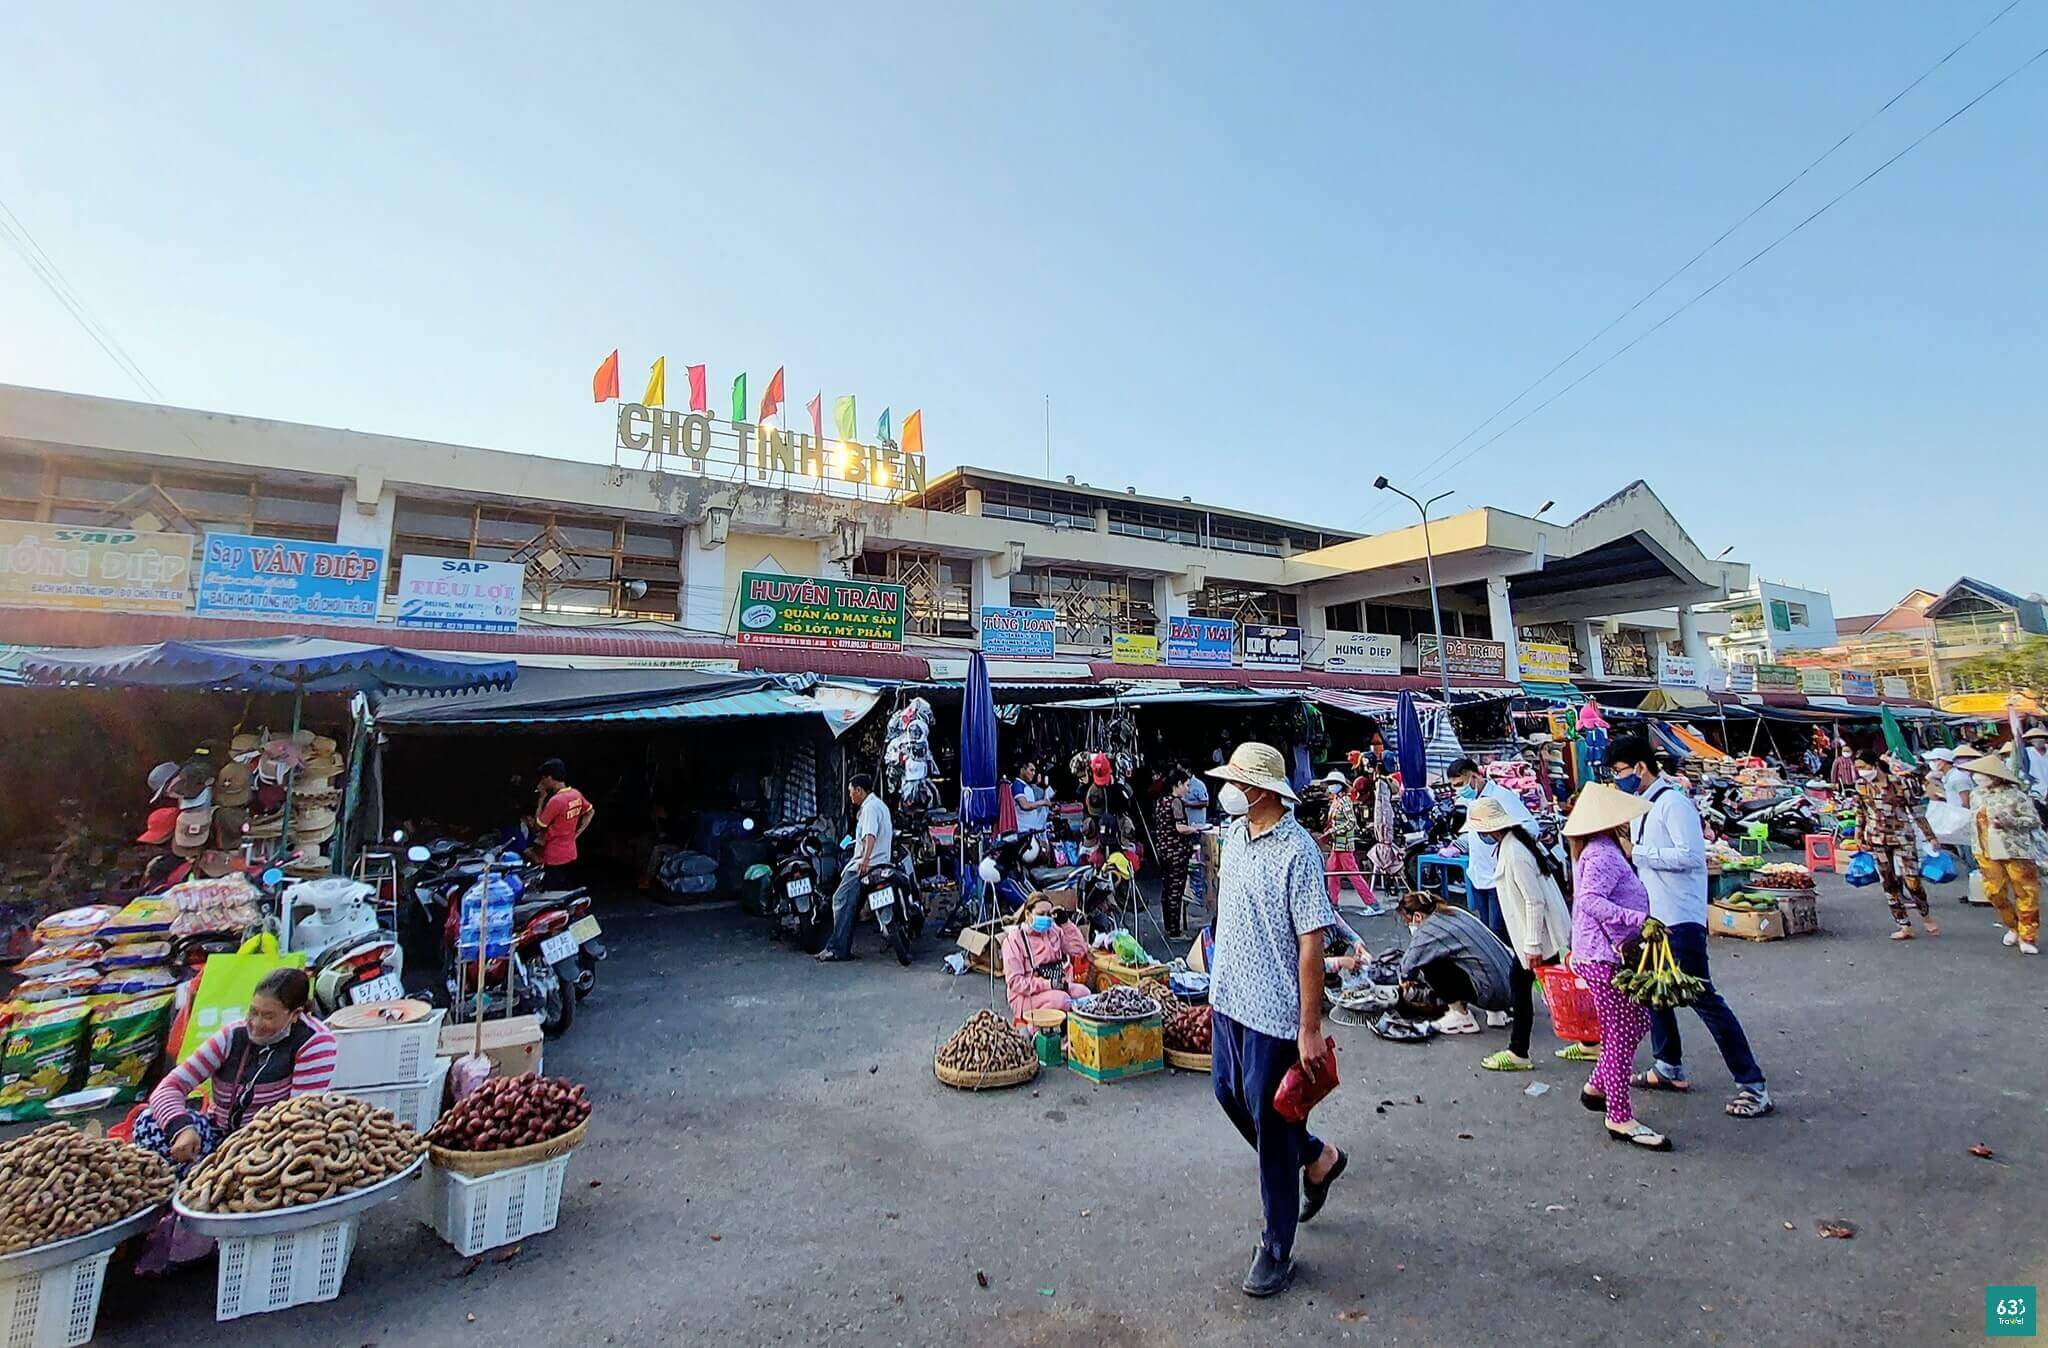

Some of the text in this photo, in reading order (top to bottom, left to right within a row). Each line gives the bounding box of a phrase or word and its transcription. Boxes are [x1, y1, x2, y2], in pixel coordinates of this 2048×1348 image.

[619, 403, 715, 471] CHỢ
[731, 421, 823, 480] TỊNH
[211, 540, 242, 569] Sạp
[251, 544, 307, 574] VÂN
[313, 551, 378, 584] ĐIỆP
[442, 560, 489, 574] SẠP
[750, 578, 898, 611] HUYỀN TRÂN
[842, 613, 869, 624] MAY
[1023, 619, 1055, 632] LOAN
[1204, 625, 1232, 641] MAI
